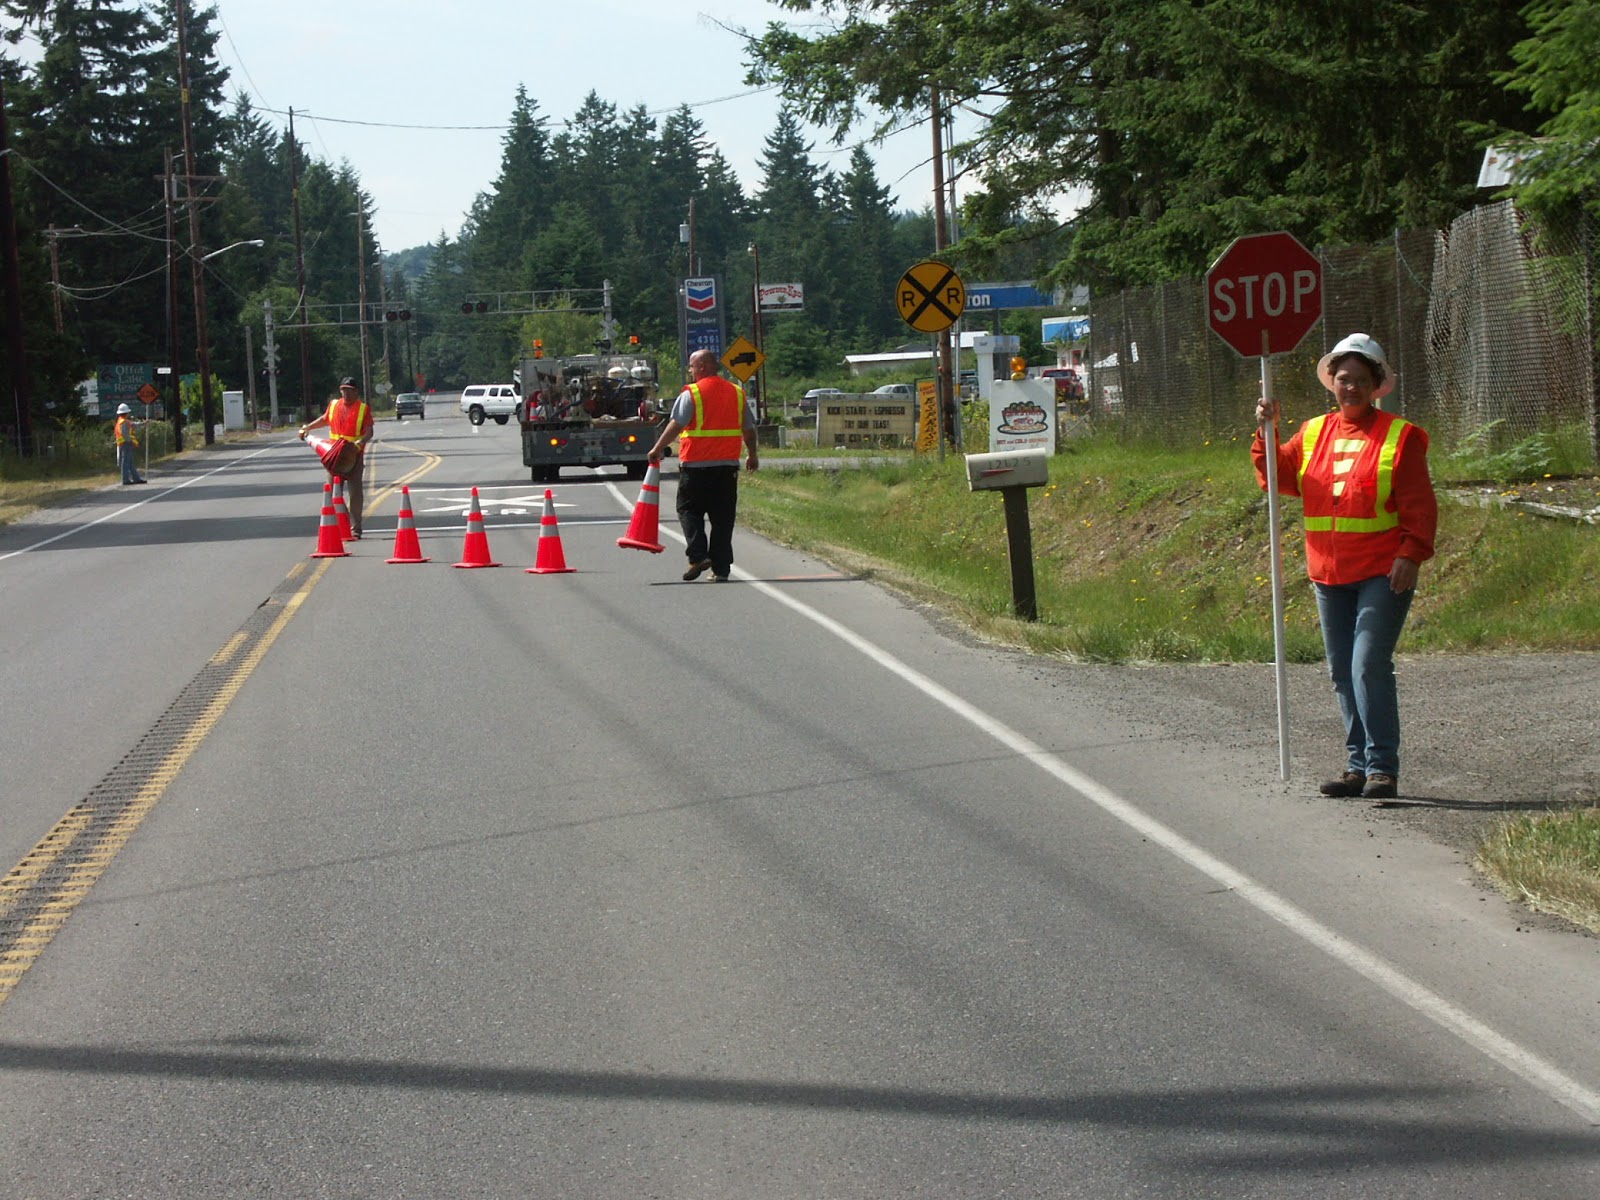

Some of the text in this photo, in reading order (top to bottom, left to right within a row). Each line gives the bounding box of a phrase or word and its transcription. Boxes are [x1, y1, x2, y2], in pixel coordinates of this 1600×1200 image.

[902, 287, 960, 307] R R
[1213, 269, 1317, 322] STOP
[827, 406, 841, 415] KICK
[845, 406, 867, 415] START
[874, 406, 906, 415] ESPRESSO
[844, 420, 855, 429] TRY
[858, 420, 869, 429] OUR
